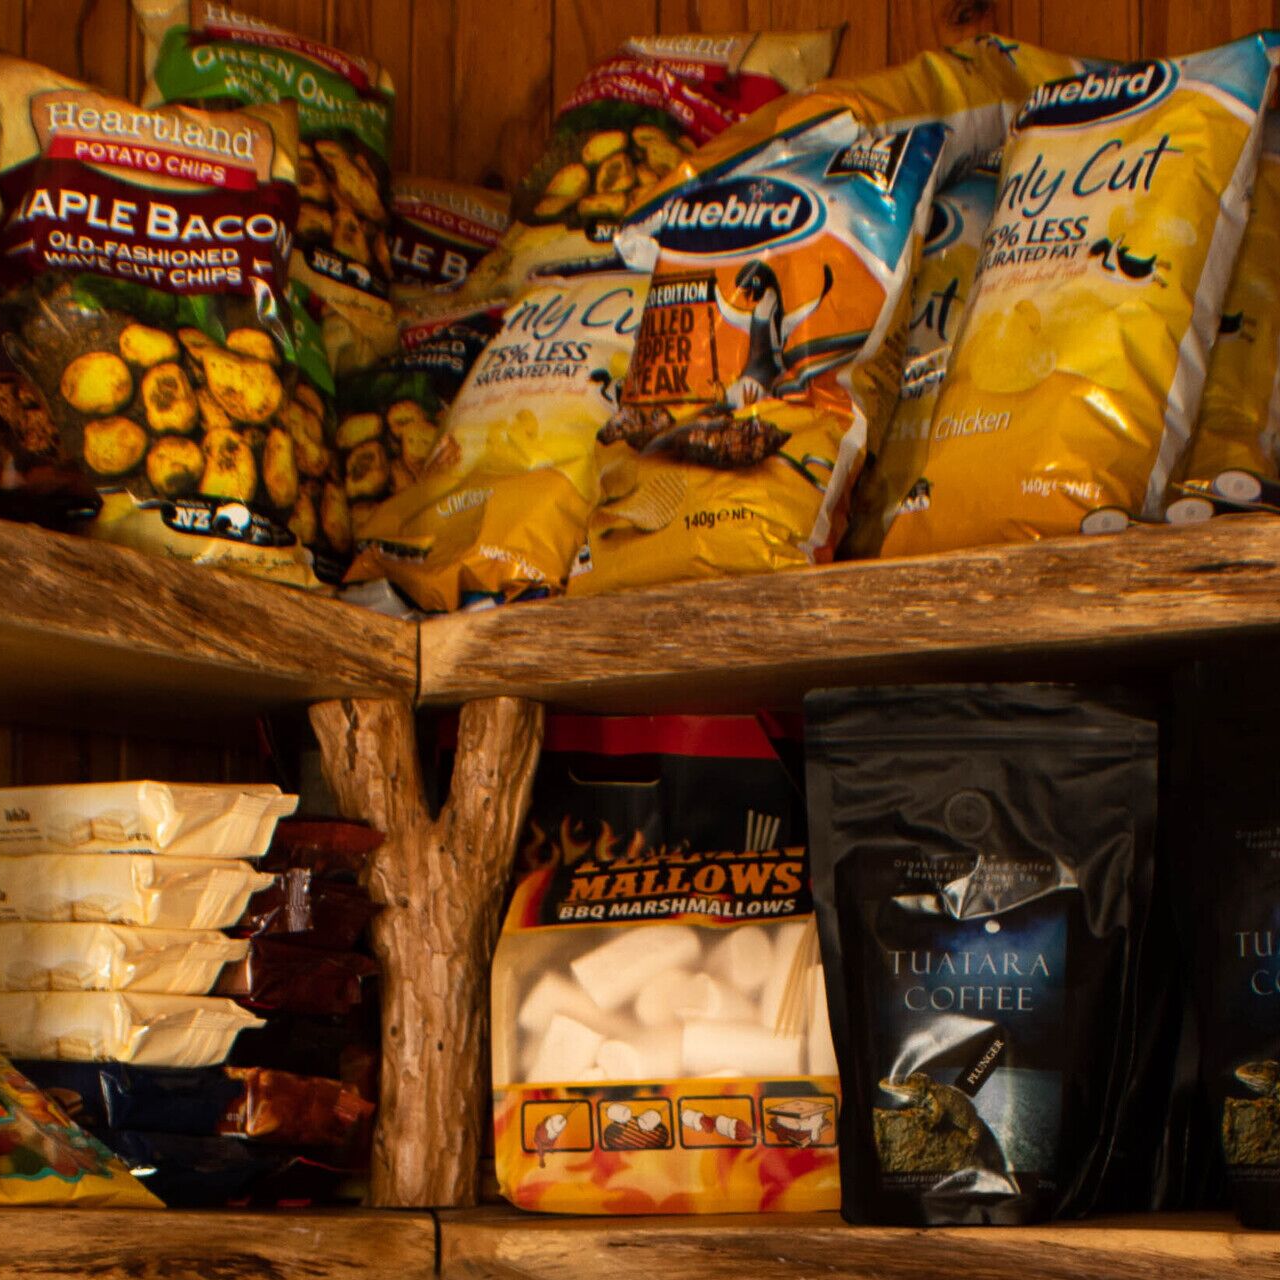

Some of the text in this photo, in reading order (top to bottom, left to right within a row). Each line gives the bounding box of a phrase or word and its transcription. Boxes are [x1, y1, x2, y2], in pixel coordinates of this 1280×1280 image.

[47, 102, 256, 162] Heartland
[75, 141, 226, 185] POTATO CHIPS
[1074, 135, 1182, 196] Cut
[49, 230, 239, 265] OLD-FASHIONED
[1027, 217, 1090, 243] LESS
[43, 251, 241, 287] WAVE CUT CHIPS
[535, 341, 592, 362] LESS
[934, 409, 1011, 440] Chicken
[567, 858, 803, 902] MALLOWS
[558, 897, 797, 922] BBQ MARSHMALLOWS
[888, 950, 1051, 977] TUATARA
[904, 986, 1034, 1012] COFFEE
[966, 1038, 1006, 1084] PLUNGER
